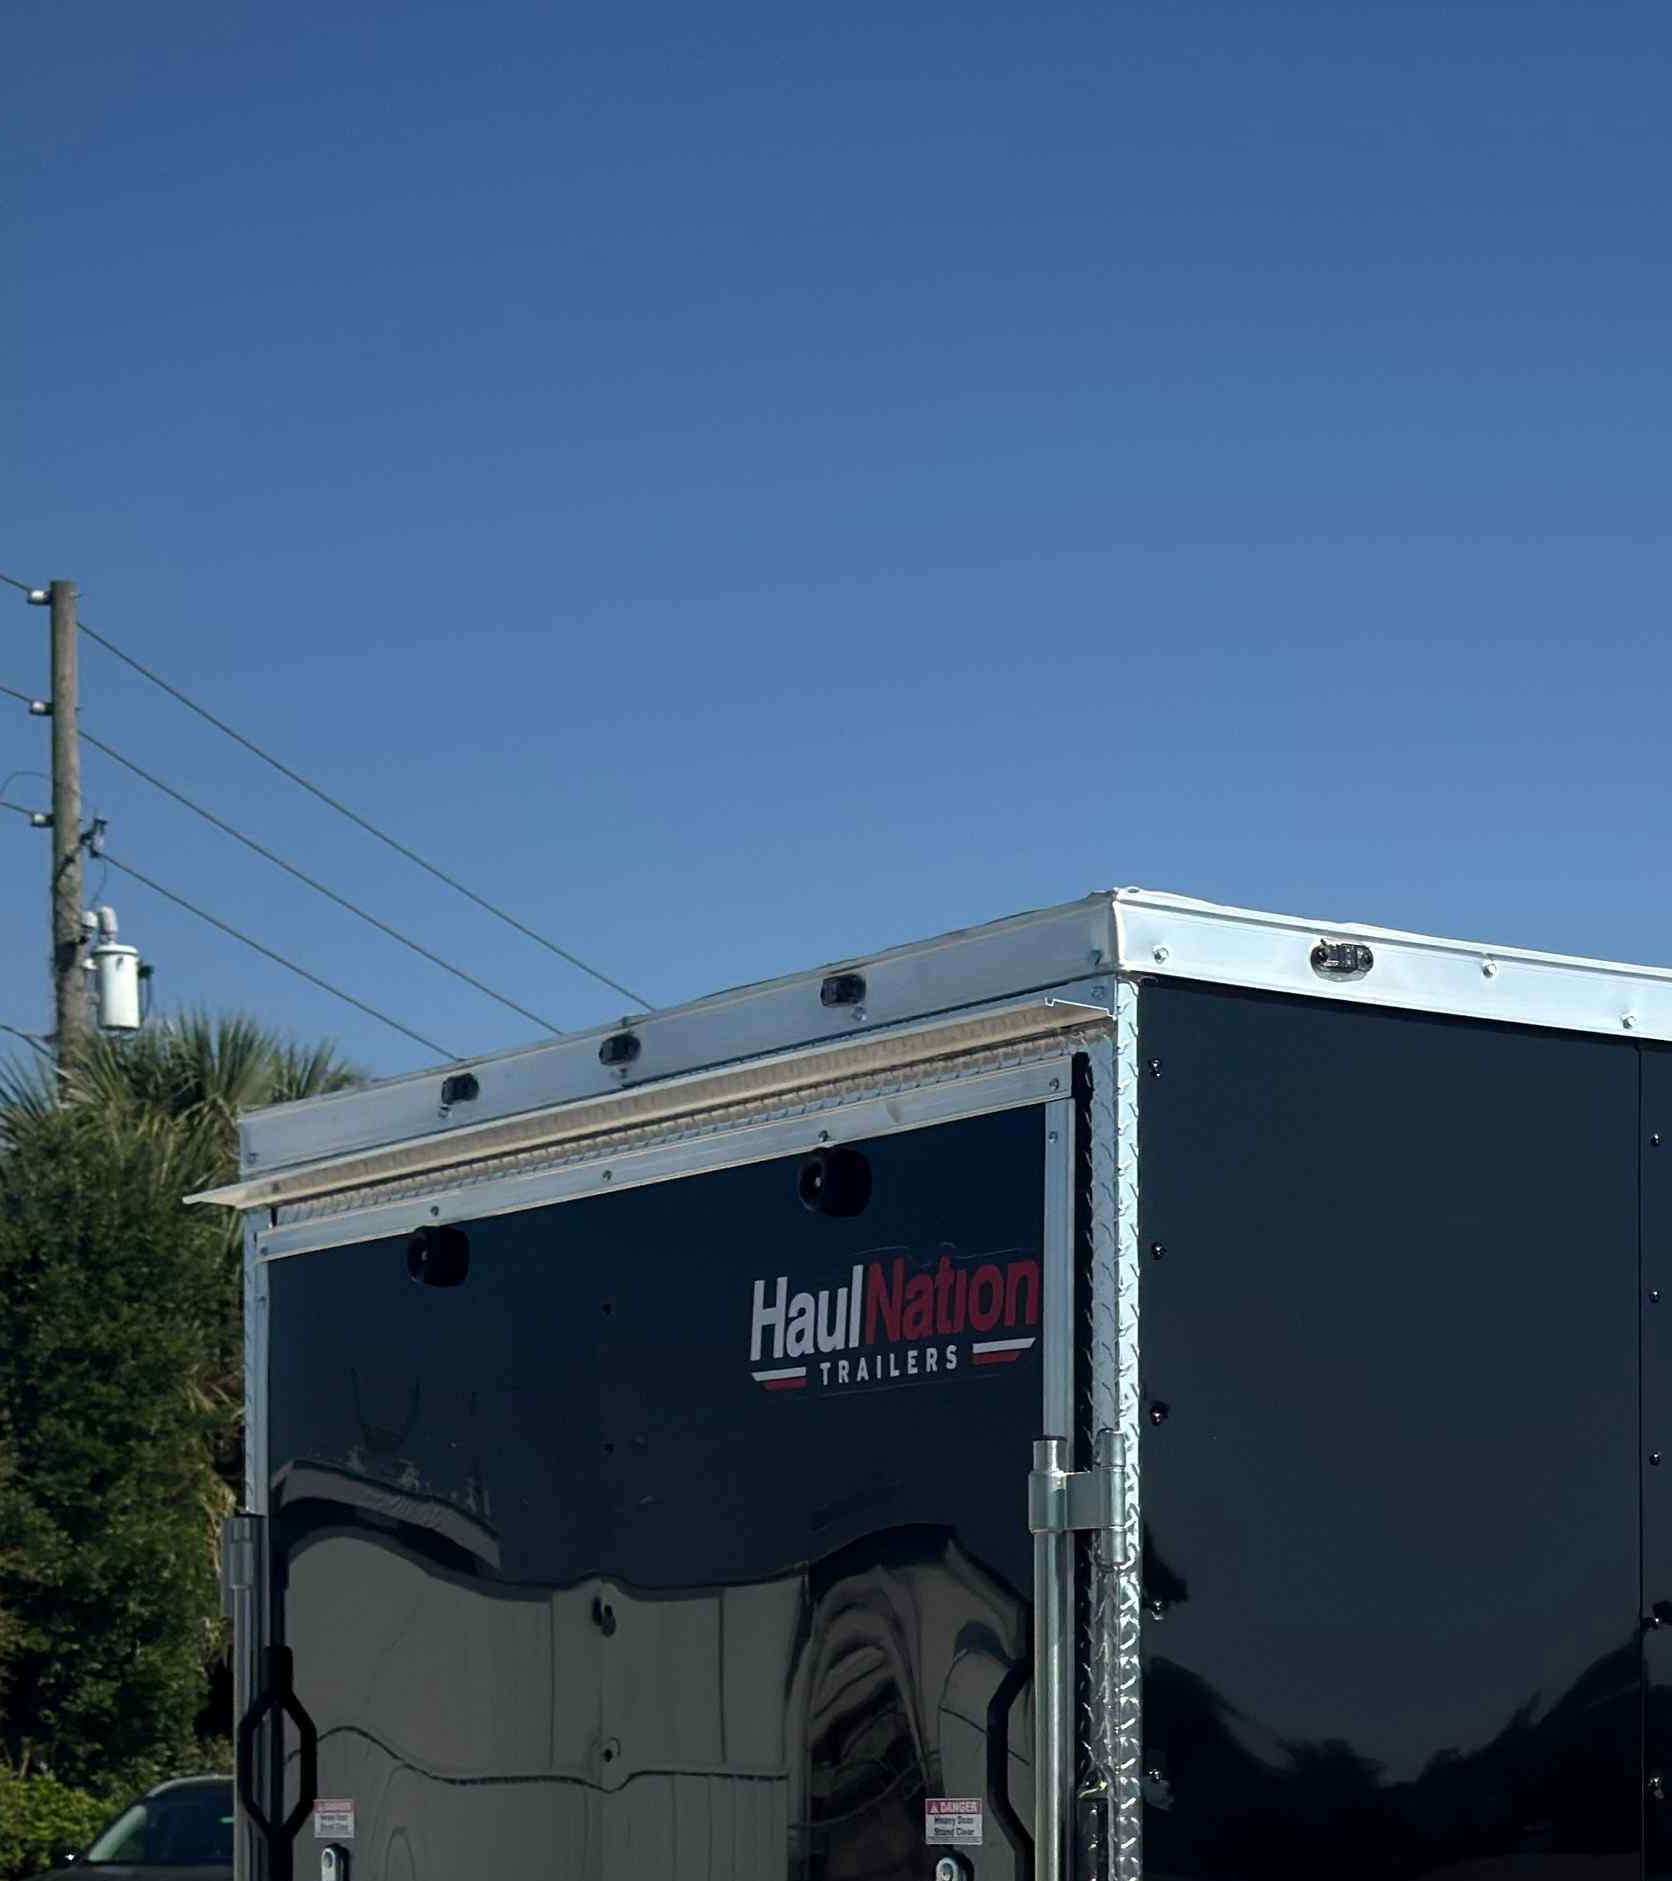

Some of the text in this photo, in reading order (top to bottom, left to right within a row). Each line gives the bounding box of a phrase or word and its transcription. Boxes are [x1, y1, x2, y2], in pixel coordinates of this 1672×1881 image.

[749, 1255, 1040, 1361] HaulNation
[819, 1345, 959, 1386] TRAILERS
[940, 1801, 977, 1814] DANGER
